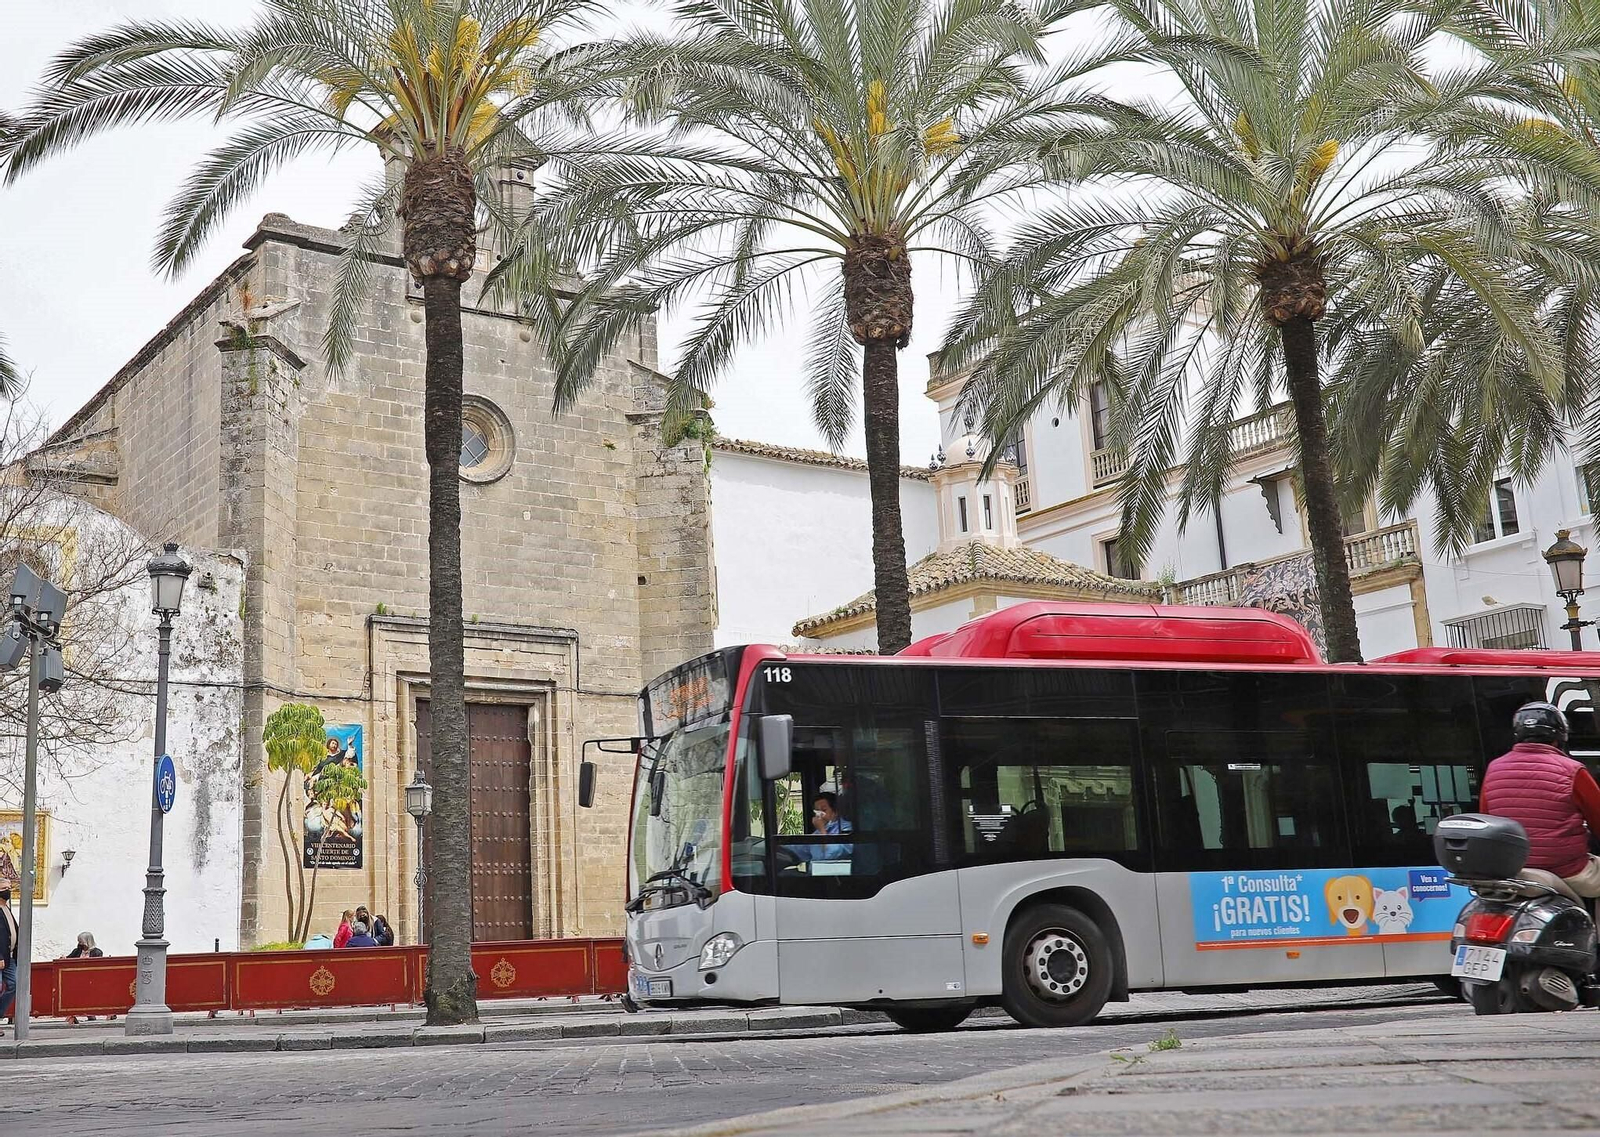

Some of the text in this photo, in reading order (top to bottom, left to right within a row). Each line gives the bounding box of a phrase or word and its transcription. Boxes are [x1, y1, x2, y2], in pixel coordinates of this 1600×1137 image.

[763, 667, 792, 683] 118
[1420, 875, 1432, 883] Ven
[1213, 894, 1311, 932] ¡GRATIS!
[1230, 926, 1300, 939] para nuevos clientes
[1466, 948, 1500, 963] 7144
[1463, 961, 1489, 975] GEP
